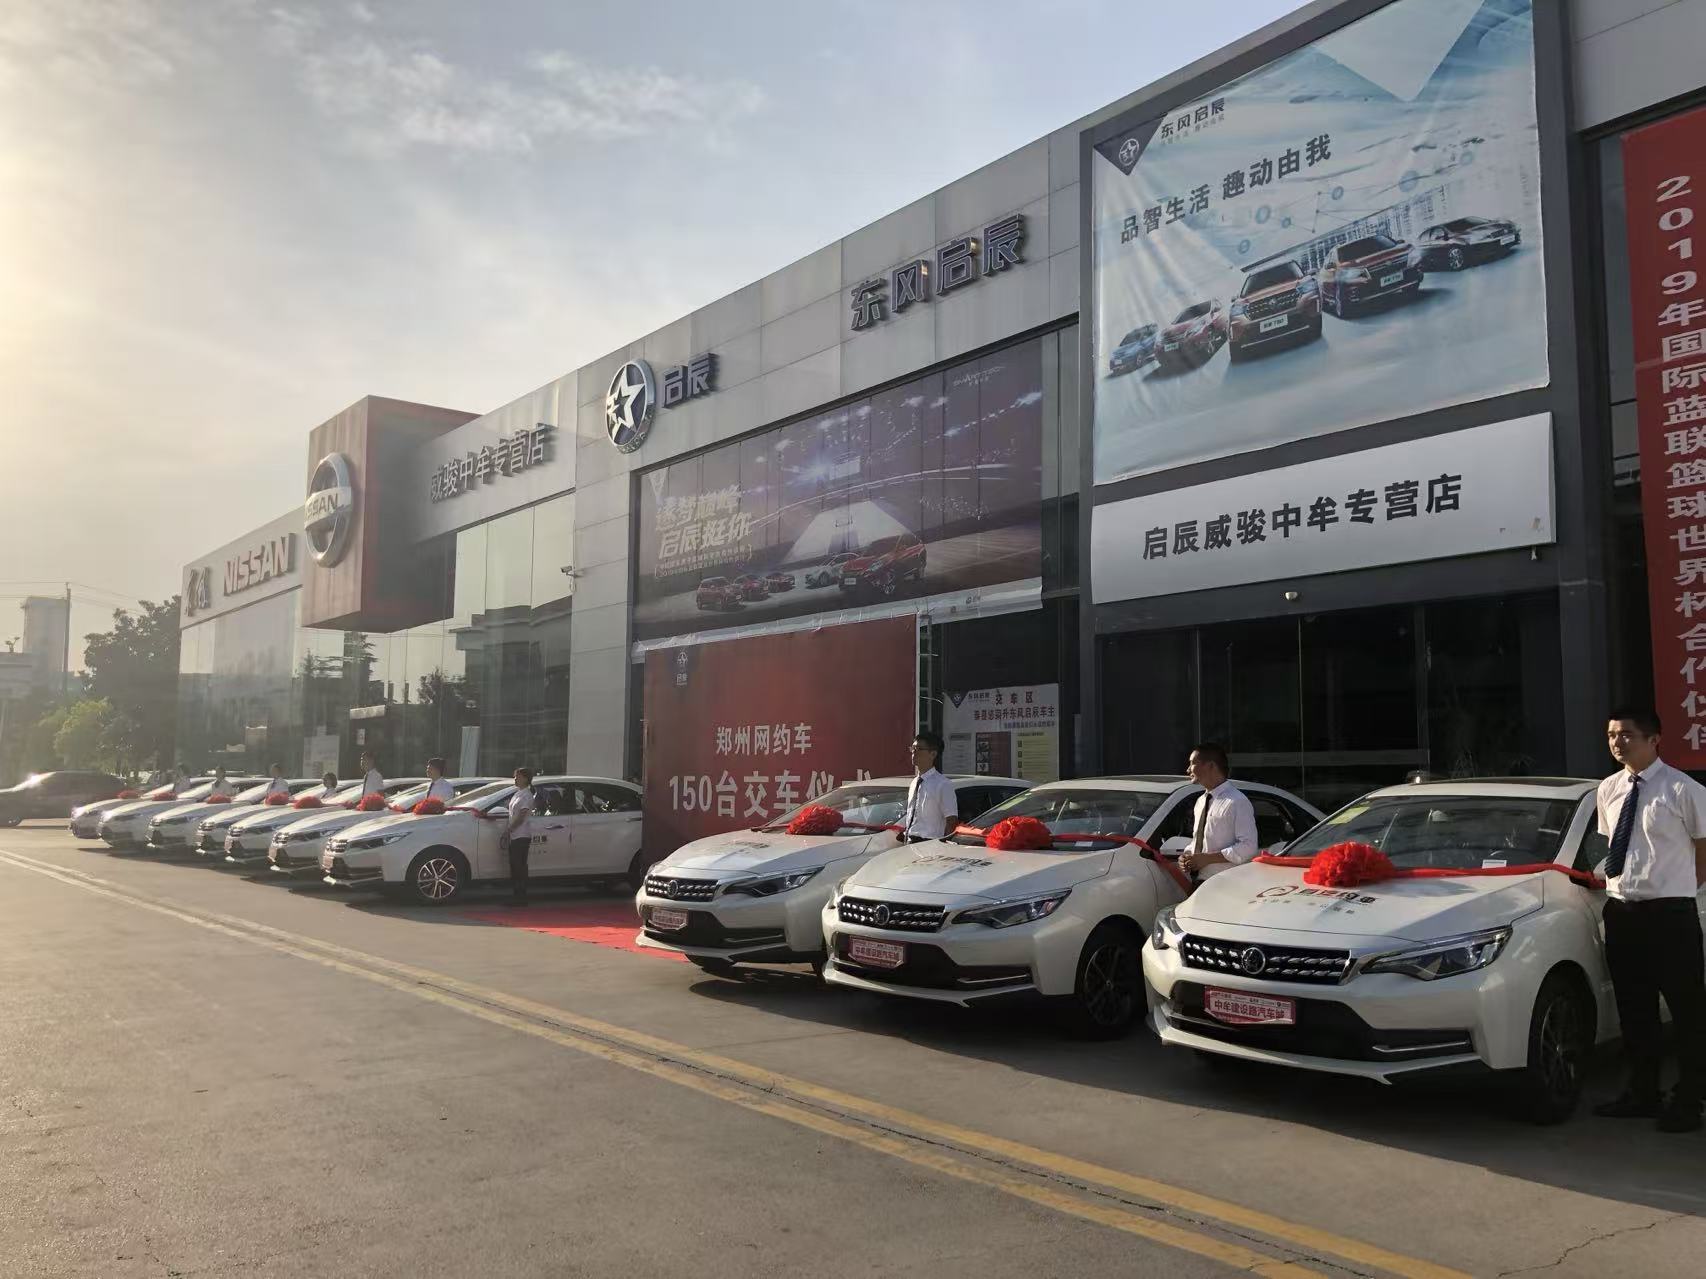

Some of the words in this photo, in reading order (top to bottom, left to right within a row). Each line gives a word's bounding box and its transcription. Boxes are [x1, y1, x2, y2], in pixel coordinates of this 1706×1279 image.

[1161, 97, 1225, 139] 东风启辰
[1120, 183, 1211, 245] 品智生活
[1222, 133, 1332, 200] 趣动由我
[850, 213, 1026, 331] 东风启辰
[662, 352, 719, 409] 启辰
[1142, 473, 1463, 561] 启辰威骏中牟专营店
[223, 532, 297, 597] NISSAN
[715, 723, 812, 756] 郑州网约车
[669, 768, 872, 819] 150台交车仪
